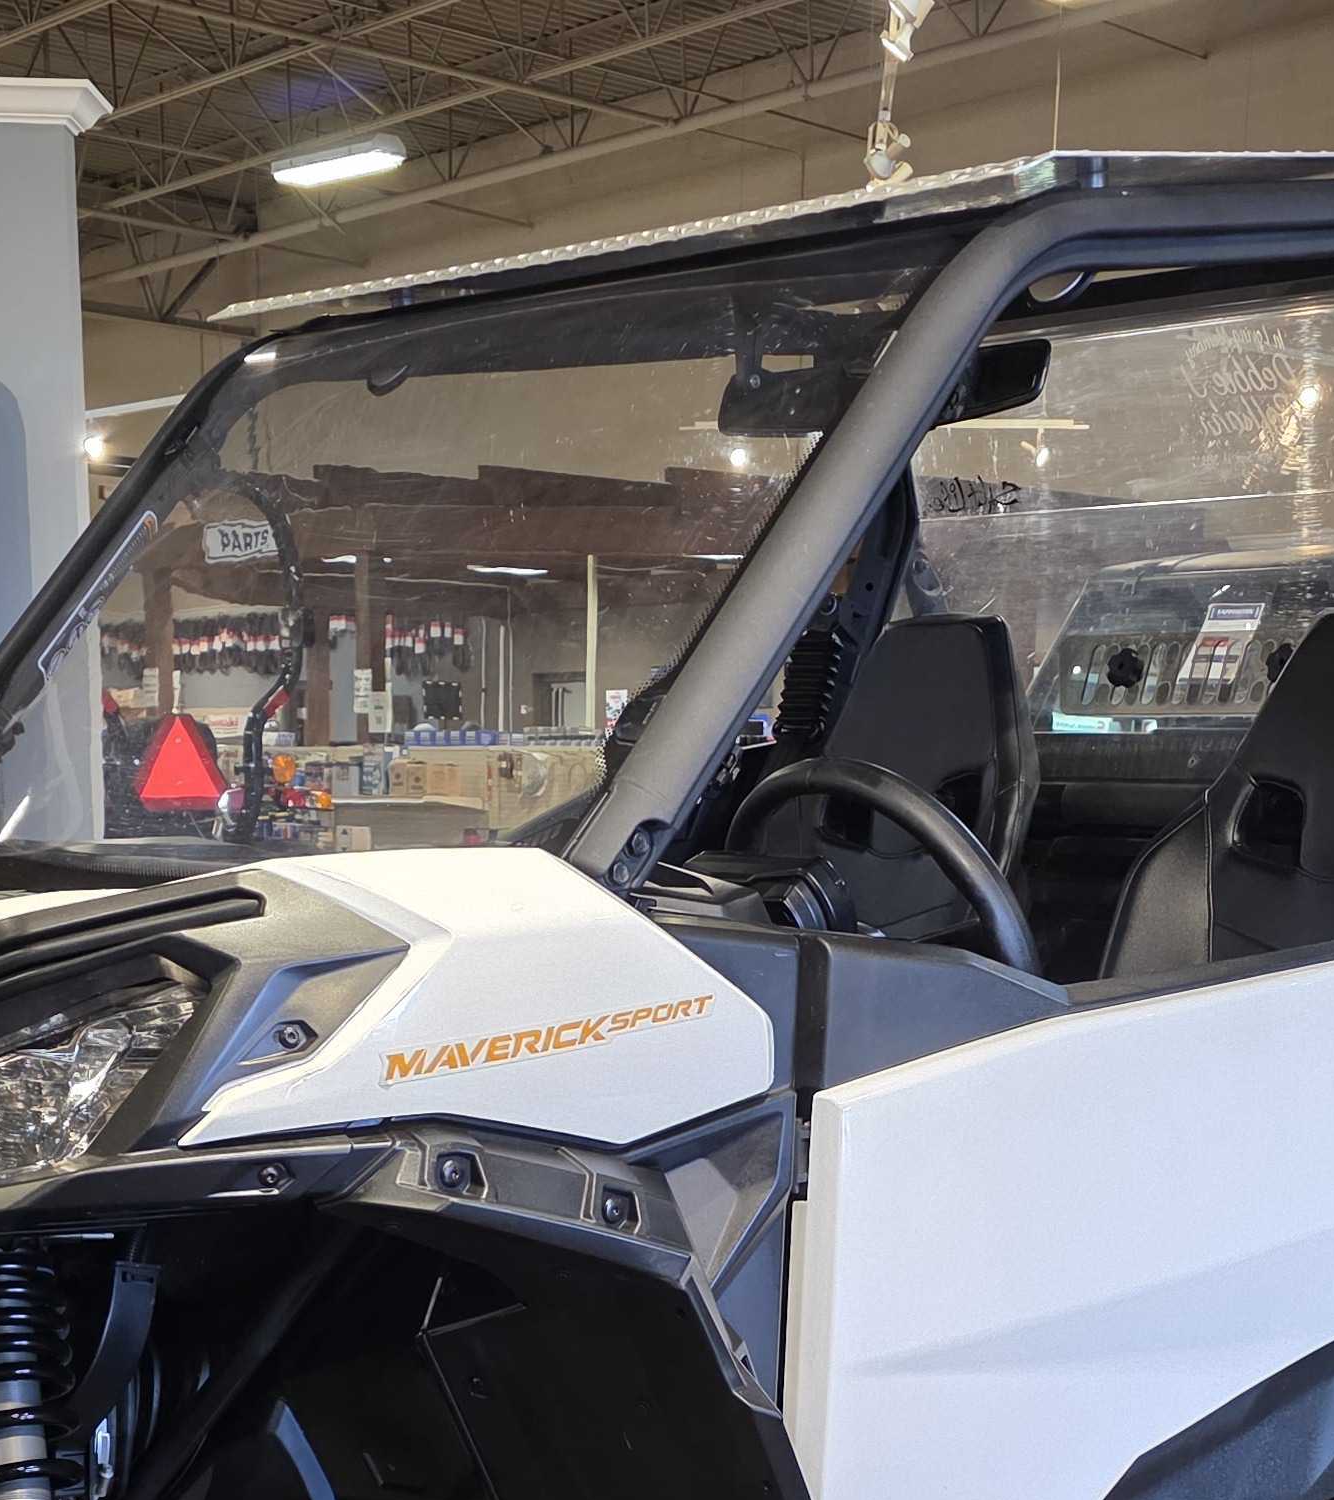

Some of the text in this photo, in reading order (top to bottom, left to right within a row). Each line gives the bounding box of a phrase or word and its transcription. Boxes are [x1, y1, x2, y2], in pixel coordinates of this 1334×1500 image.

[218, 528, 269, 552] PARTS
[384, 995, 713, 1081] MAVERICK SPORT
